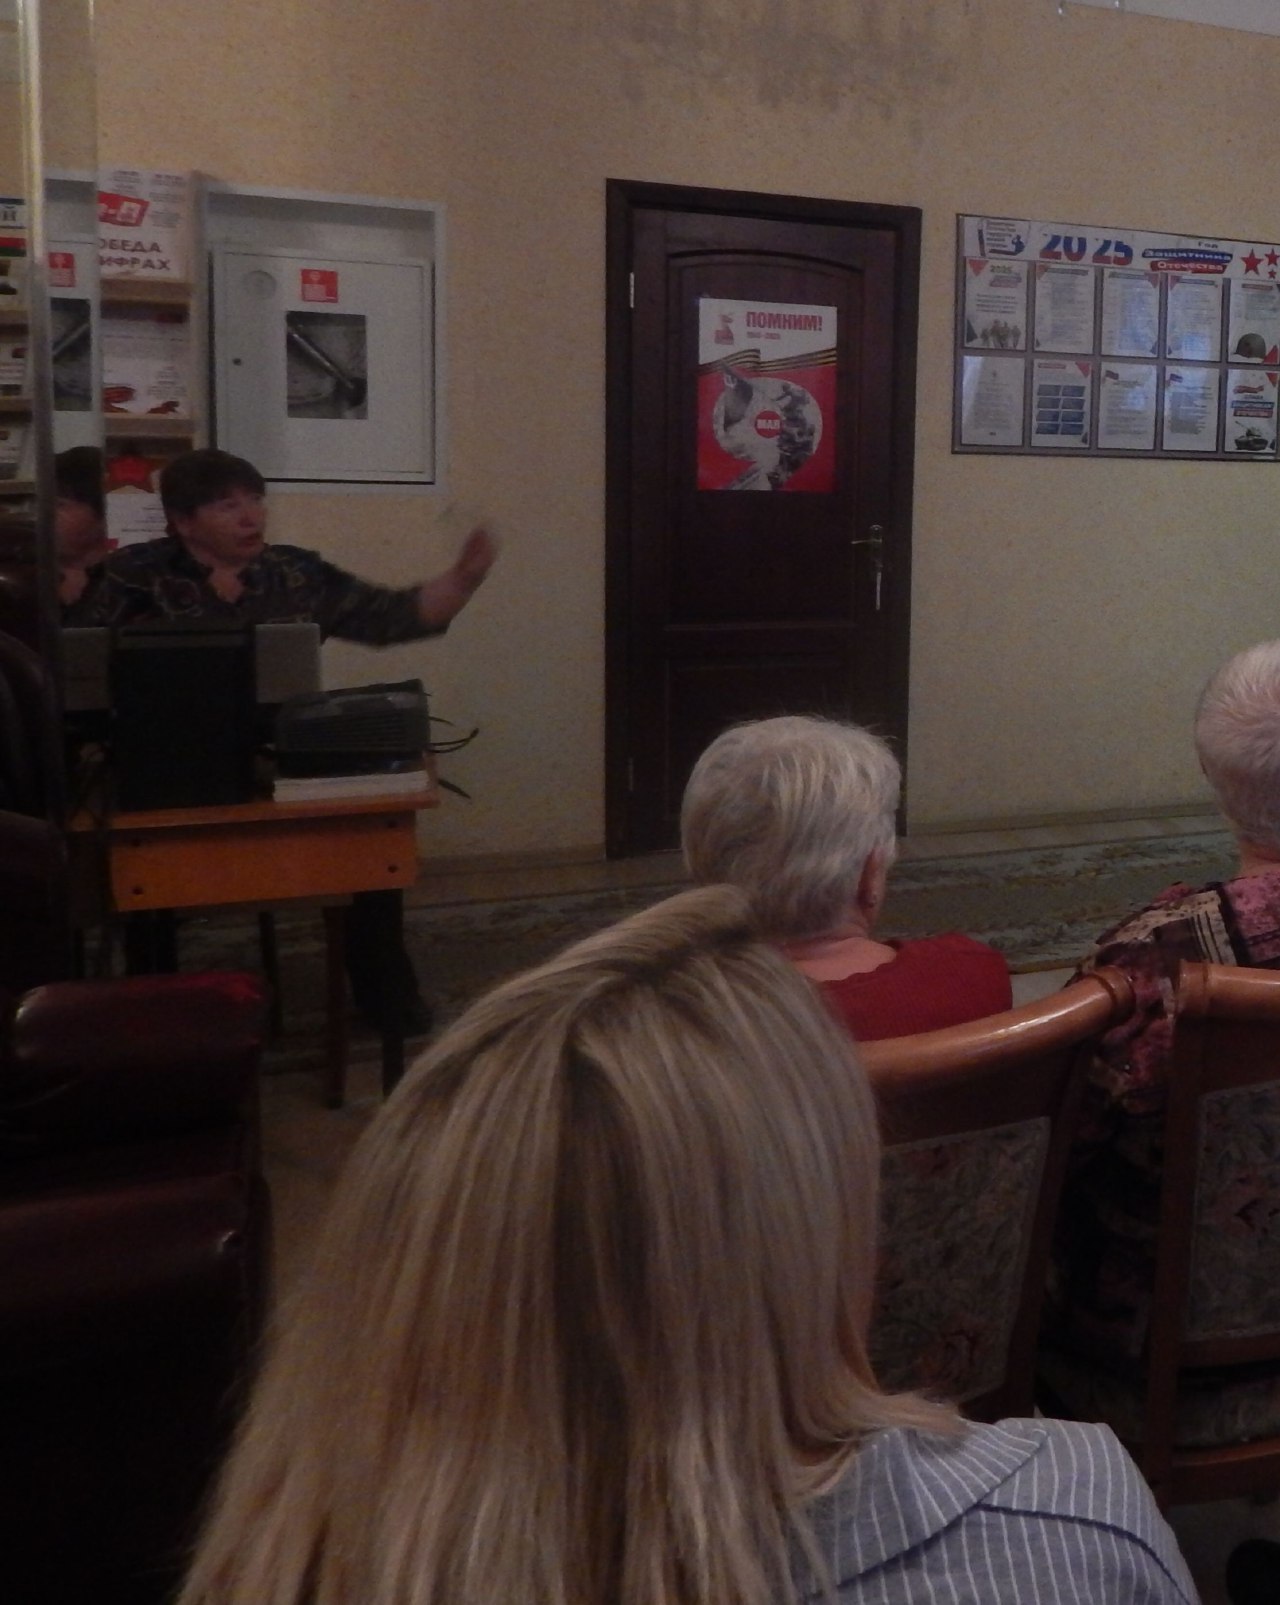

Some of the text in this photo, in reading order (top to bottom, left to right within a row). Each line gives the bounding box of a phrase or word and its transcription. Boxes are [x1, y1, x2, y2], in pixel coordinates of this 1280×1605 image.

[1144, 248, 1232, 261] Защитника
[1156, 261, 1224, 272] Отечества
[746, 311, 823, 332] ПОМНИМ!
